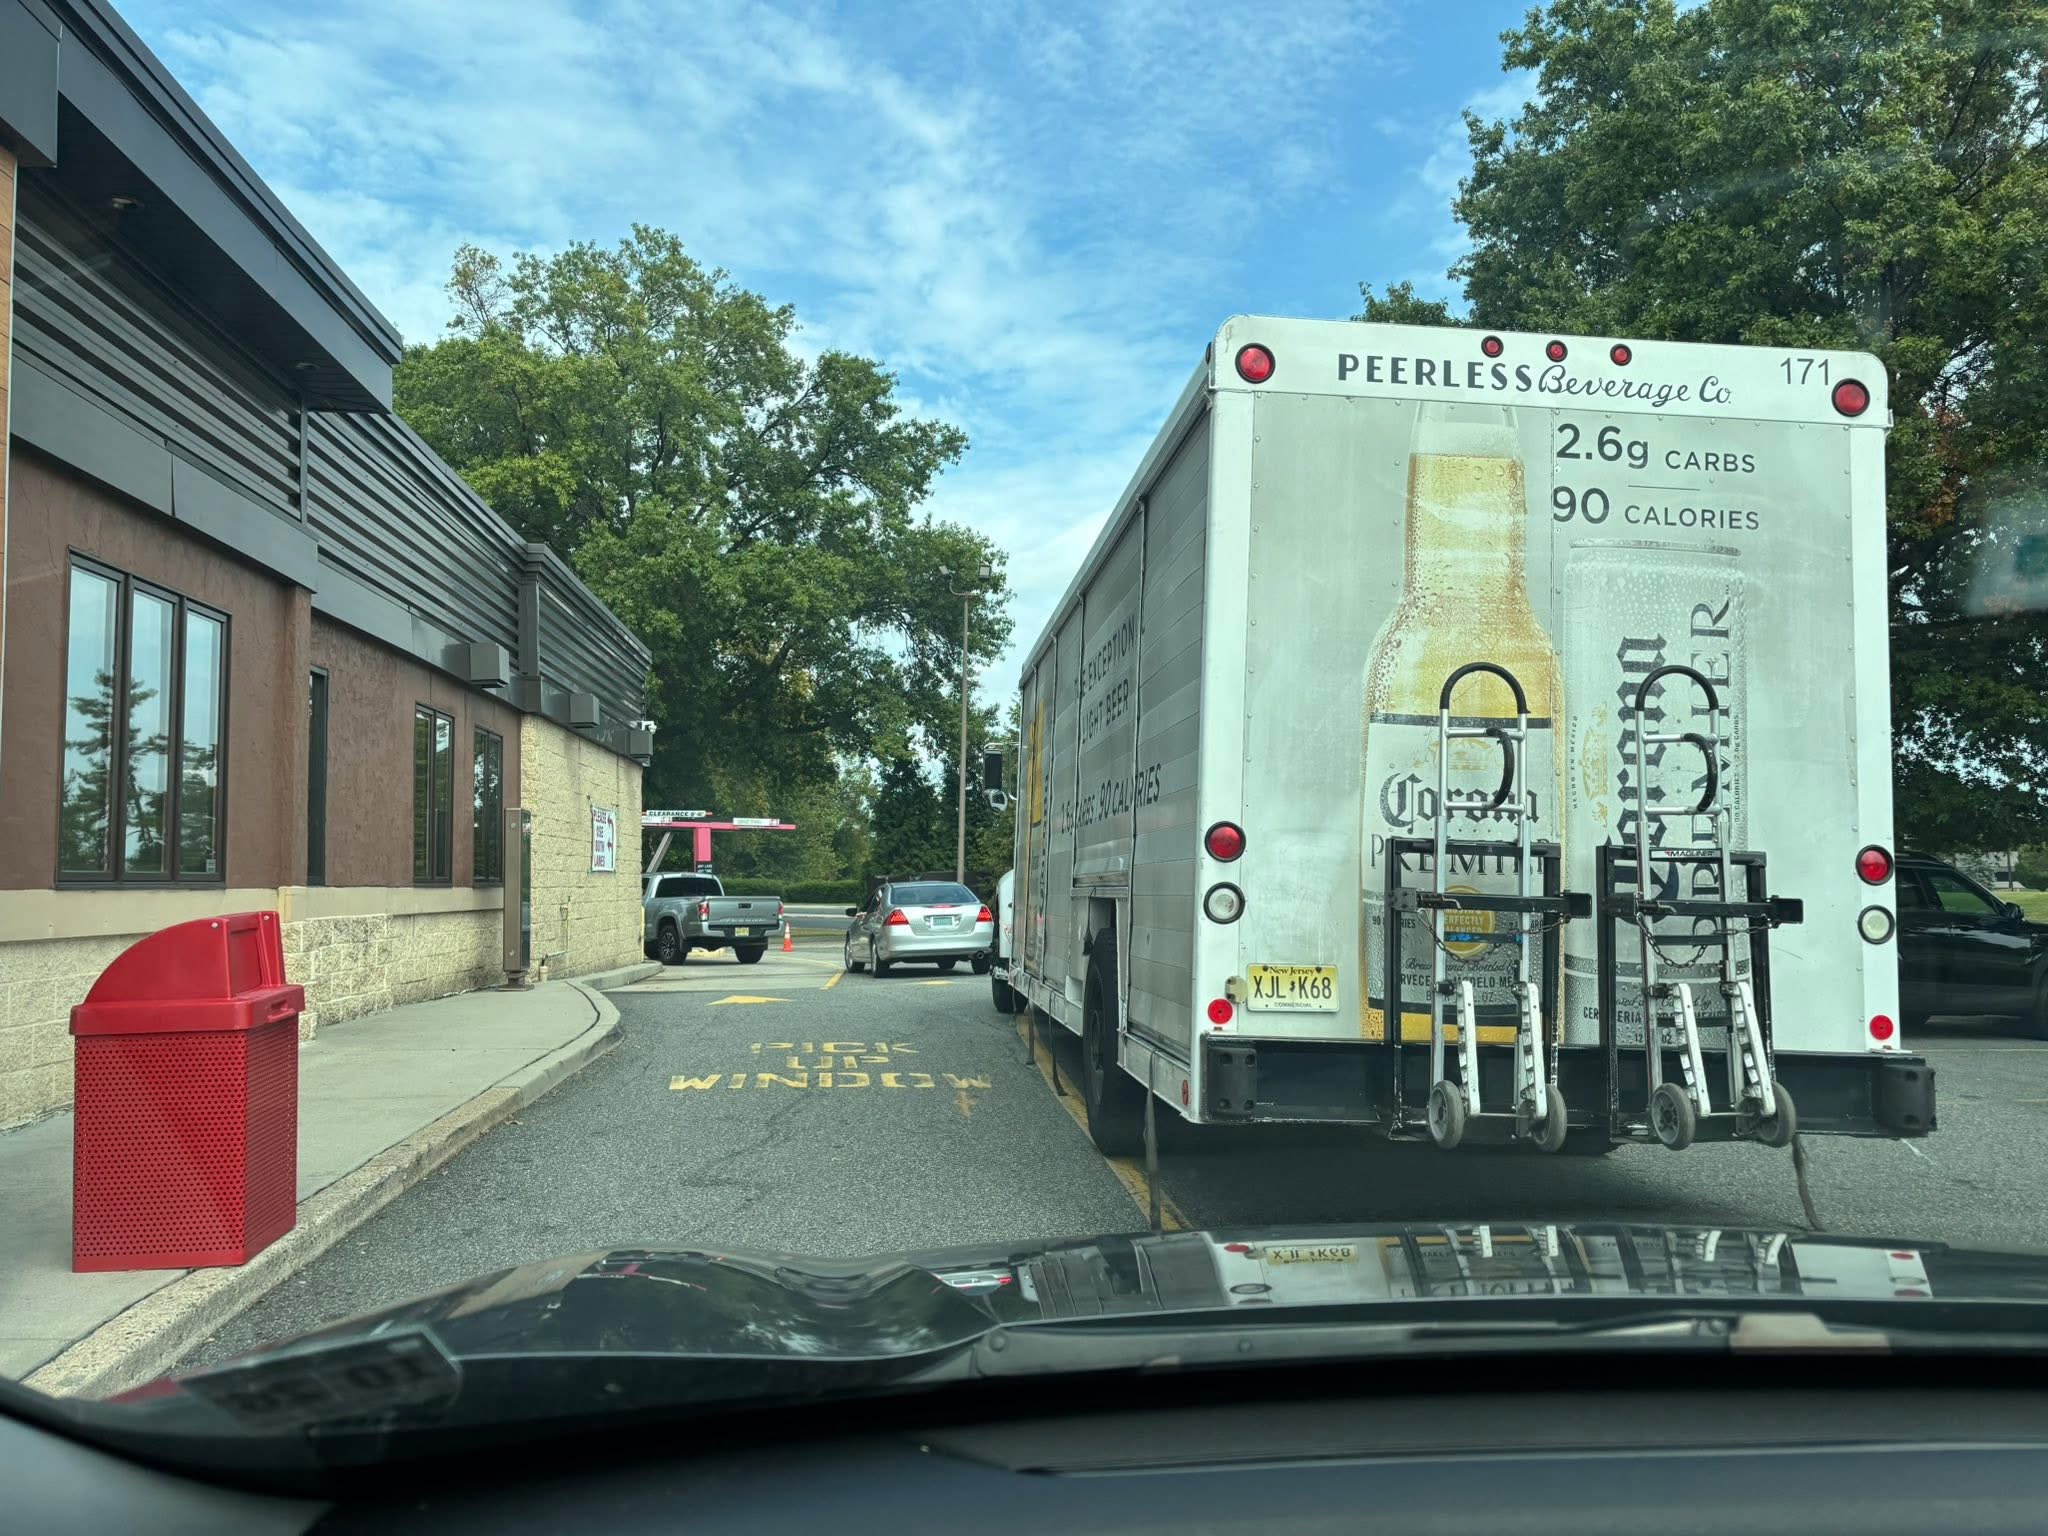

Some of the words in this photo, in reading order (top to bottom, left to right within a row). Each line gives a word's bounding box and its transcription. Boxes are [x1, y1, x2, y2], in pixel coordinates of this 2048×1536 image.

[1338, 352, 1532, 392] PEERLESS
[1538, 364, 1691, 408] Beverage
[1779, 357, 1832, 387] 171
[1556, 422, 1650, 469] 2.6g
[1665, 449, 1756, 474] CARBS
[1552, 485, 1610, 525] 90
[1624, 504, 1760, 531] CALORIES
[1106, 678, 1129, 727] BEER
[1444, 915, 1484, 926] ERFECTLY
[1253, 975, 1287, 998] XJL
[1298, 975, 1332, 999] K68
[750, 1041, 920, 1053] PICK
[786, 1055, 890, 1069] UP
[668, 1071, 993, 1090] WINDOW
